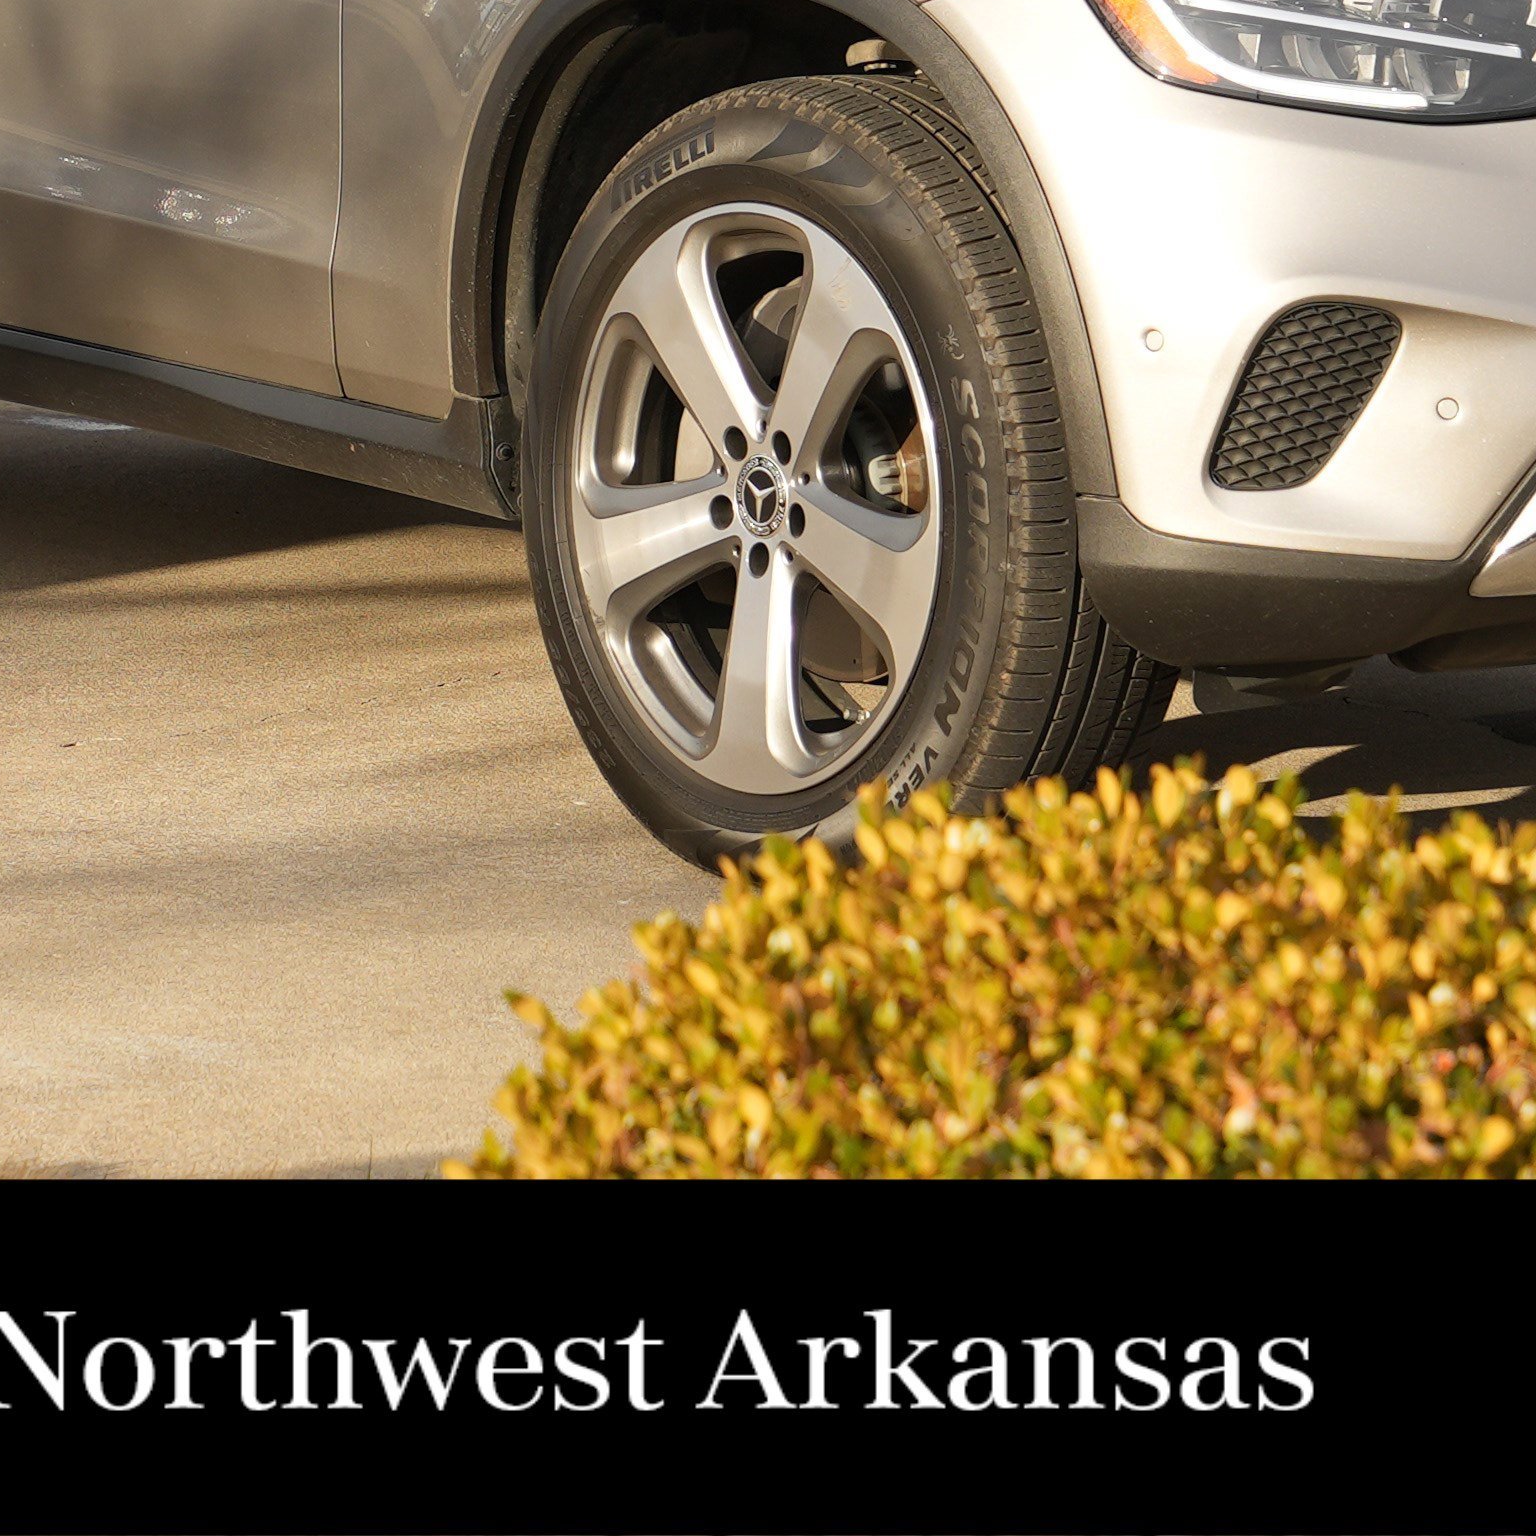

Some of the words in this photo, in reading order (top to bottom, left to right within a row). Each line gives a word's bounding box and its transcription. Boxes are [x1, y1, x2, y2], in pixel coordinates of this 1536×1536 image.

[610, 116, 716, 214] PIRELLI
[934, 375, 991, 737] SCORPION
[886, 745, 939, 809] VER
